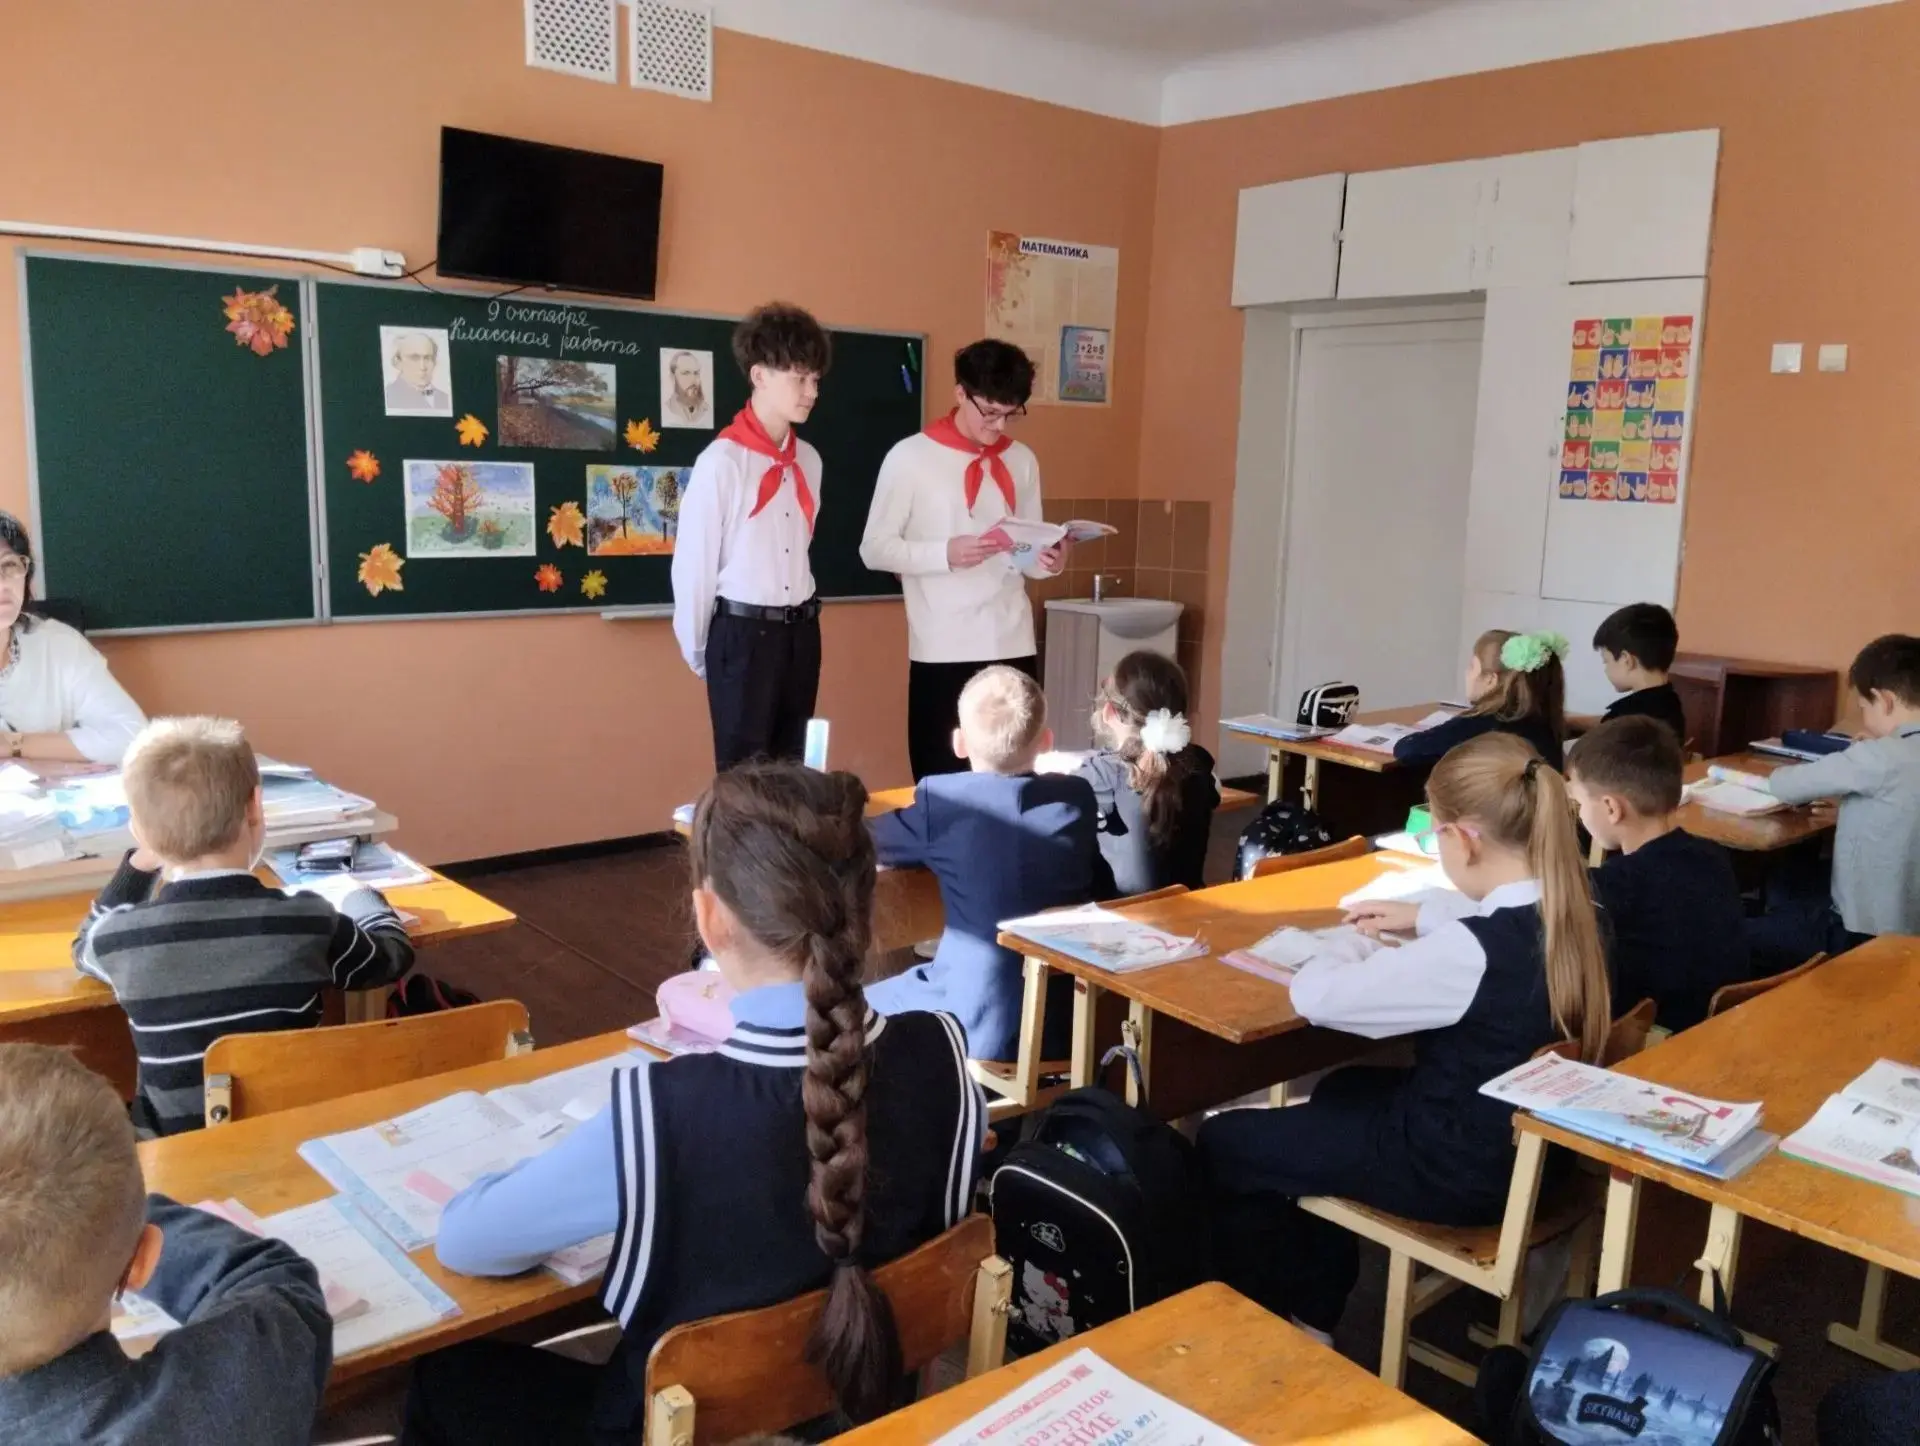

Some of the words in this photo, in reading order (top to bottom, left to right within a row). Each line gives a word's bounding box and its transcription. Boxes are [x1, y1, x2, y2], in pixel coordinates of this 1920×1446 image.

[1021, 240, 1089, 259] МАТЕМАТИКА
[487, 301, 500, 322] 9
[505, 305, 590, 334] октября
[449, 316, 551, 348] Классная
[559, 326, 641, 358] работа
[1019, 1388, 1113, 1446] ратурное
[1056, 1411, 1120, 1446] НИЕ
